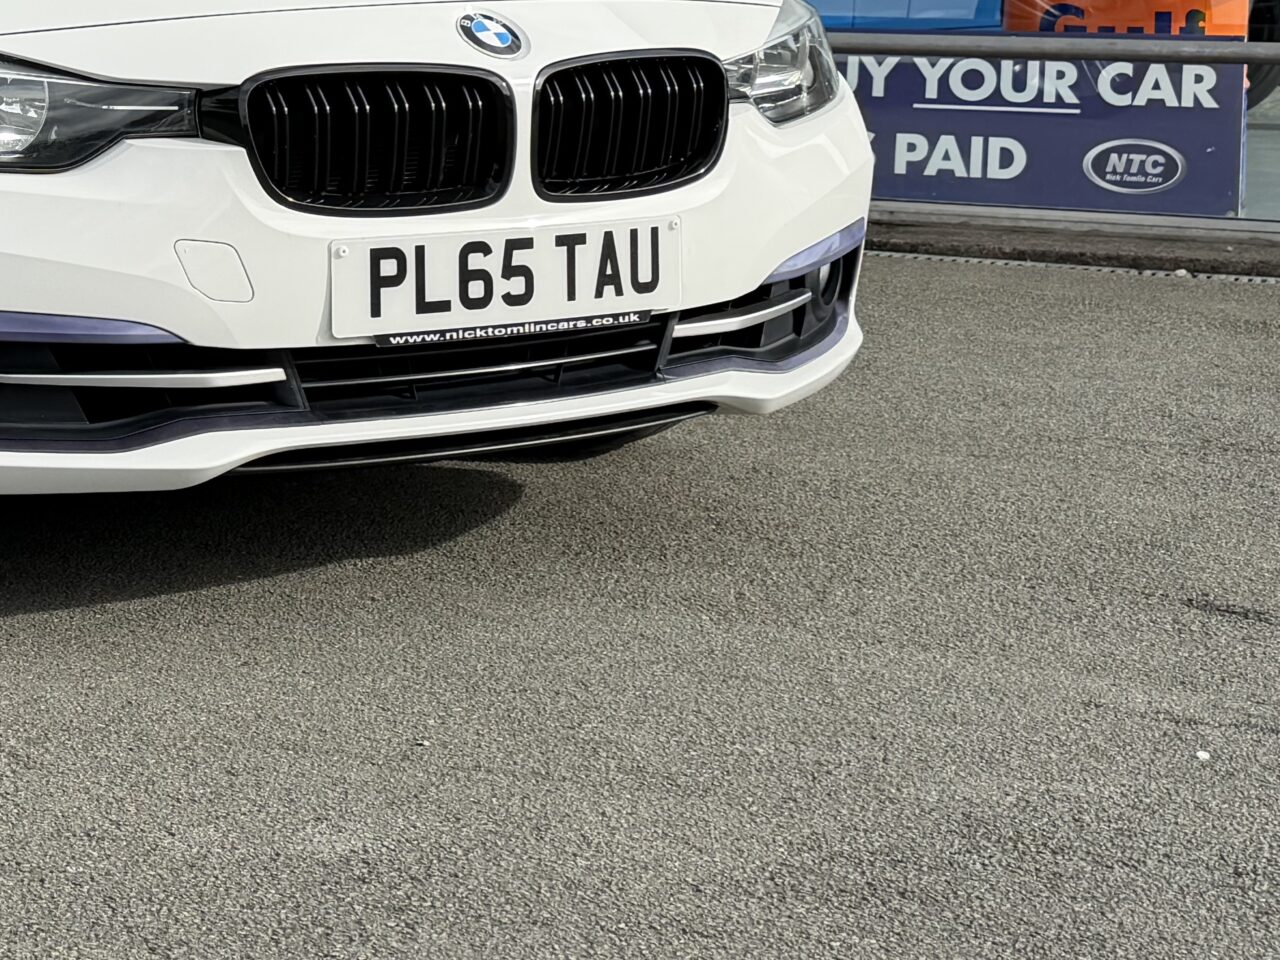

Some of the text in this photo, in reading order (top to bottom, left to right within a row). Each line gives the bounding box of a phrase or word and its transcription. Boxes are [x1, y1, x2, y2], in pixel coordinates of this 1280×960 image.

[1038, 2, 1207, 37] Glf
[914, 58, 1081, 106] YOUR
[1097, 62, 1220, 109] CAR
[893, 132, 1028, 181] PAID
[1105, 152, 1166, 174] NTC
[370, 226, 660, 318] PL65 TAU
[389, 311, 641, 345] www.nicktomlincars.co.uk
